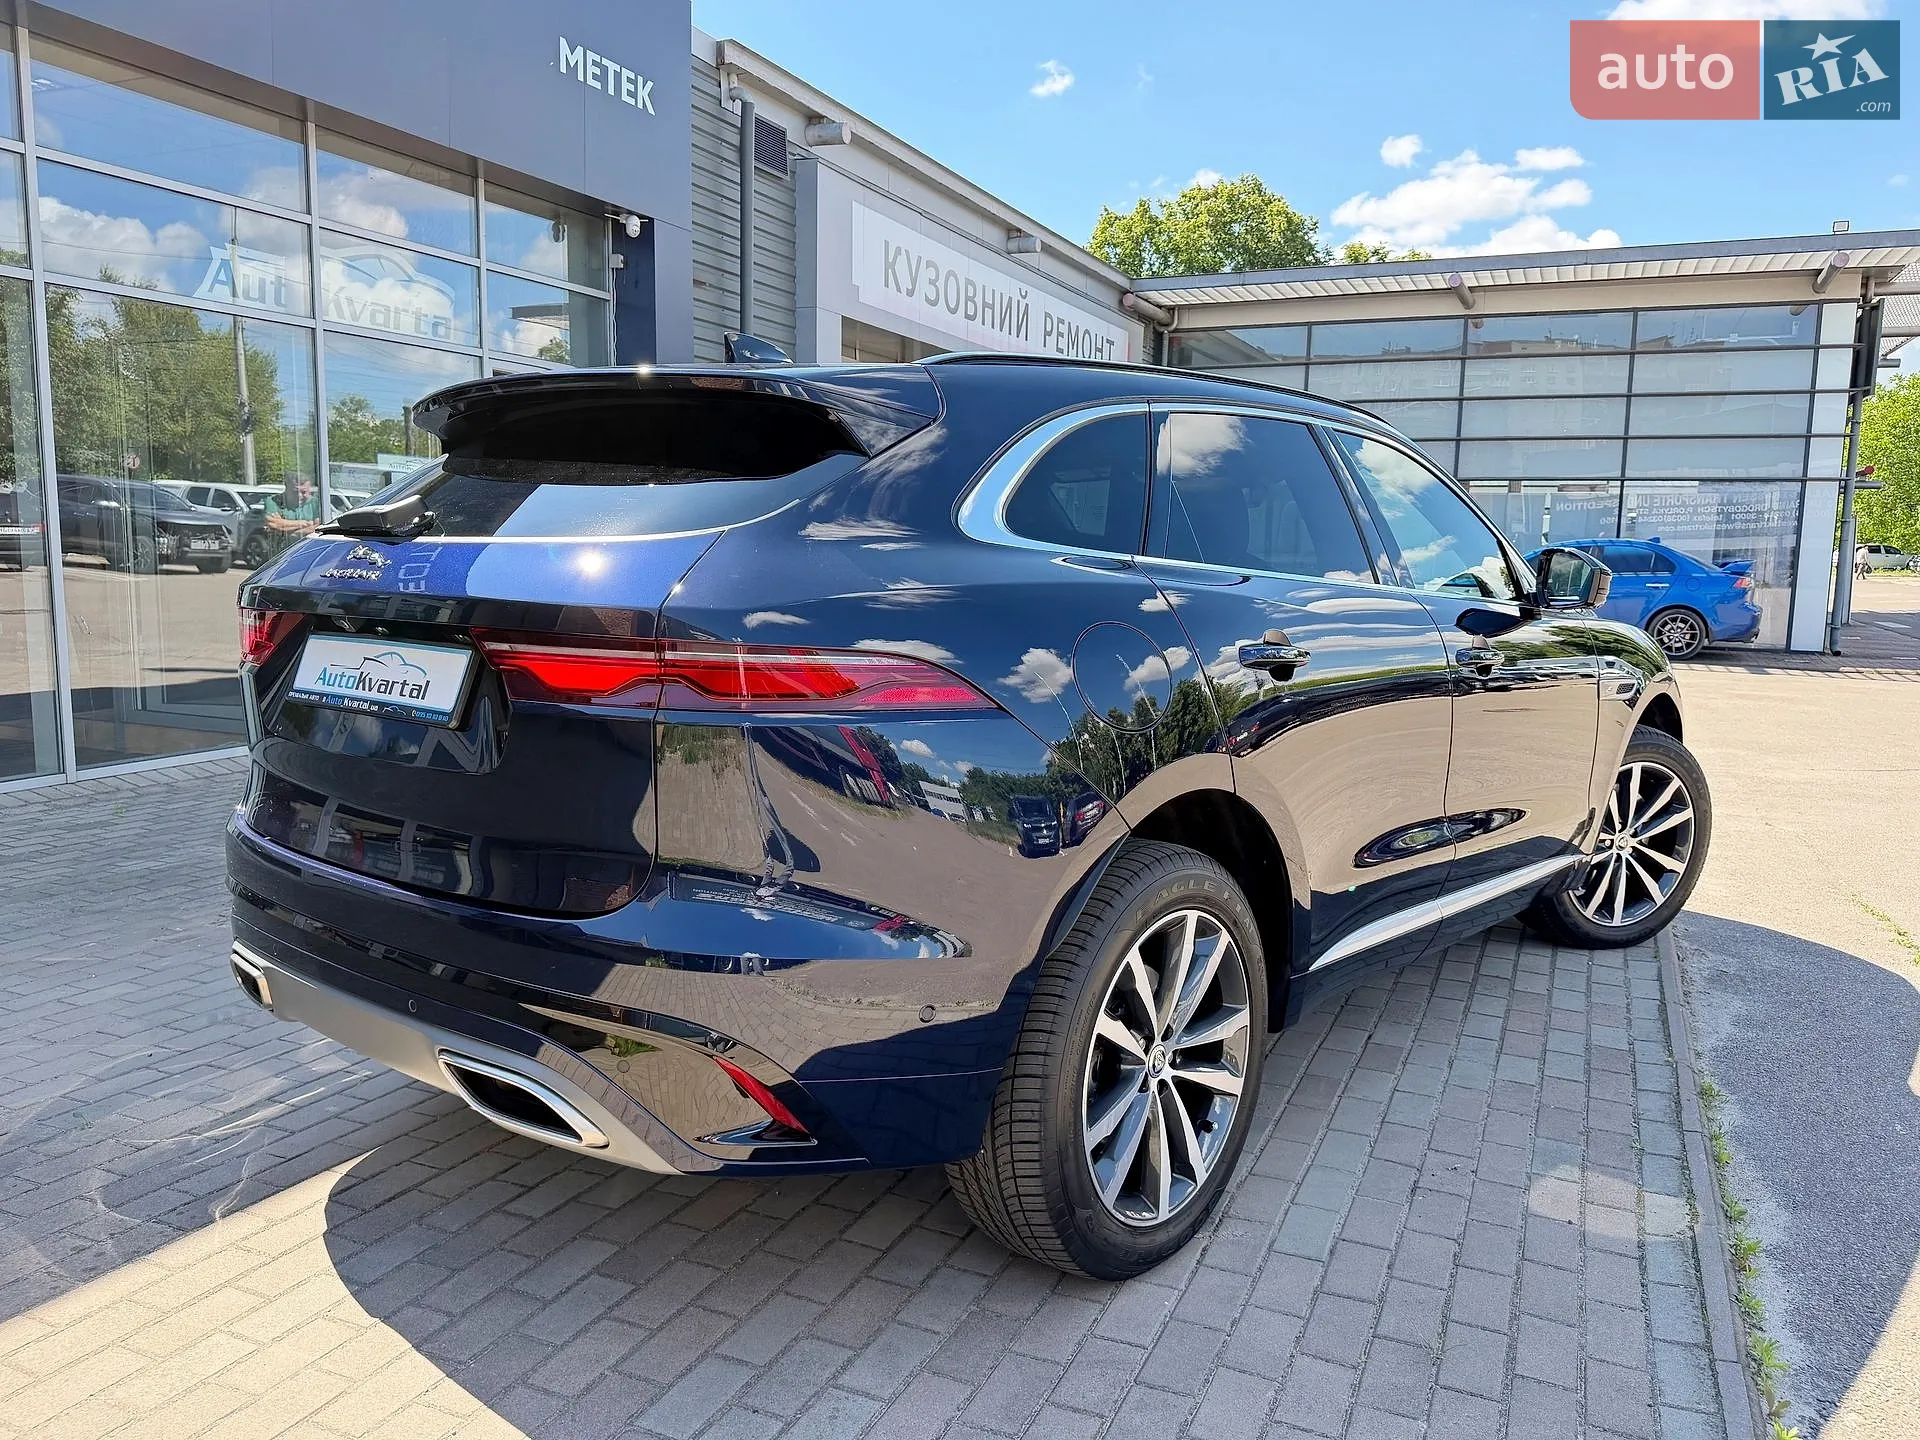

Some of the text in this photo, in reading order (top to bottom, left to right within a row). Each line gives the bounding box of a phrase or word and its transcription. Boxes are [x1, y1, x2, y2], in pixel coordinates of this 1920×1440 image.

[559, 35, 656, 117] METEK
[883, 239, 1115, 361] КУЗОВНИЙ РЕМОНТ
[314, 666, 431, 701] AutoKvartal
